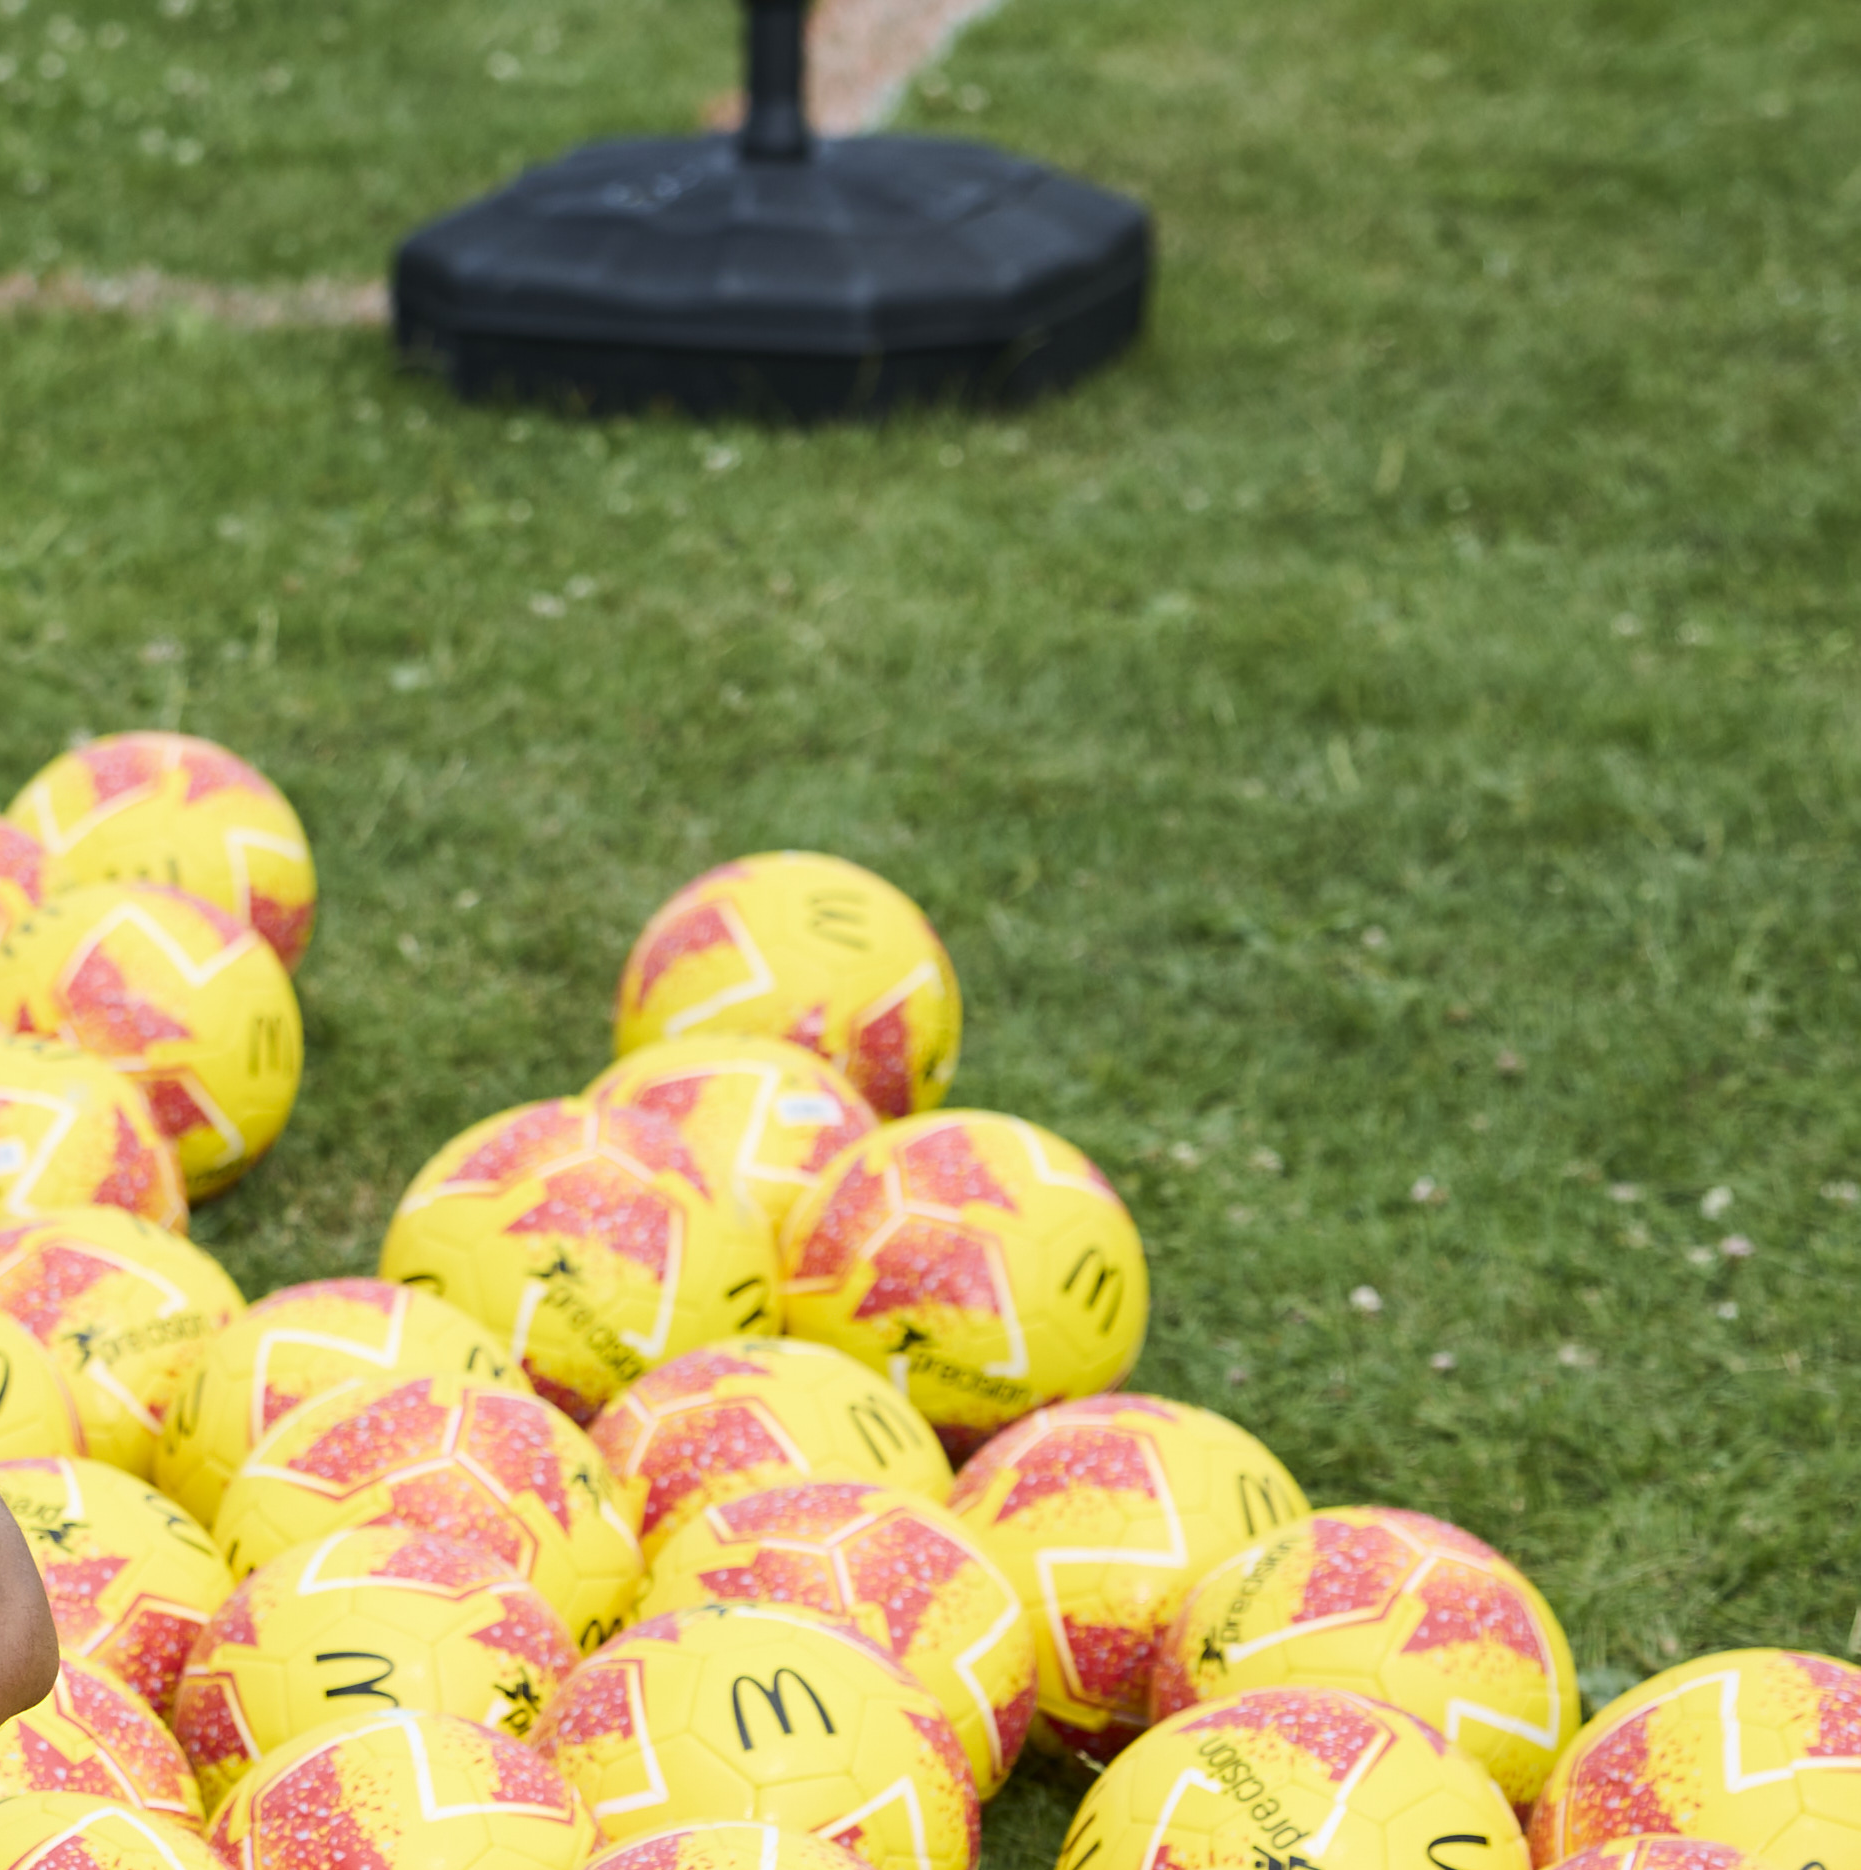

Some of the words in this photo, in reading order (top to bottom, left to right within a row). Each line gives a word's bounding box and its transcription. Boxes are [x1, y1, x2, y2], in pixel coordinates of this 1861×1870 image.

[1239, 1474, 1295, 1537] M
[731, 1667, 837, 1752] M
[1196, 1737, 1313, 1850] precision
